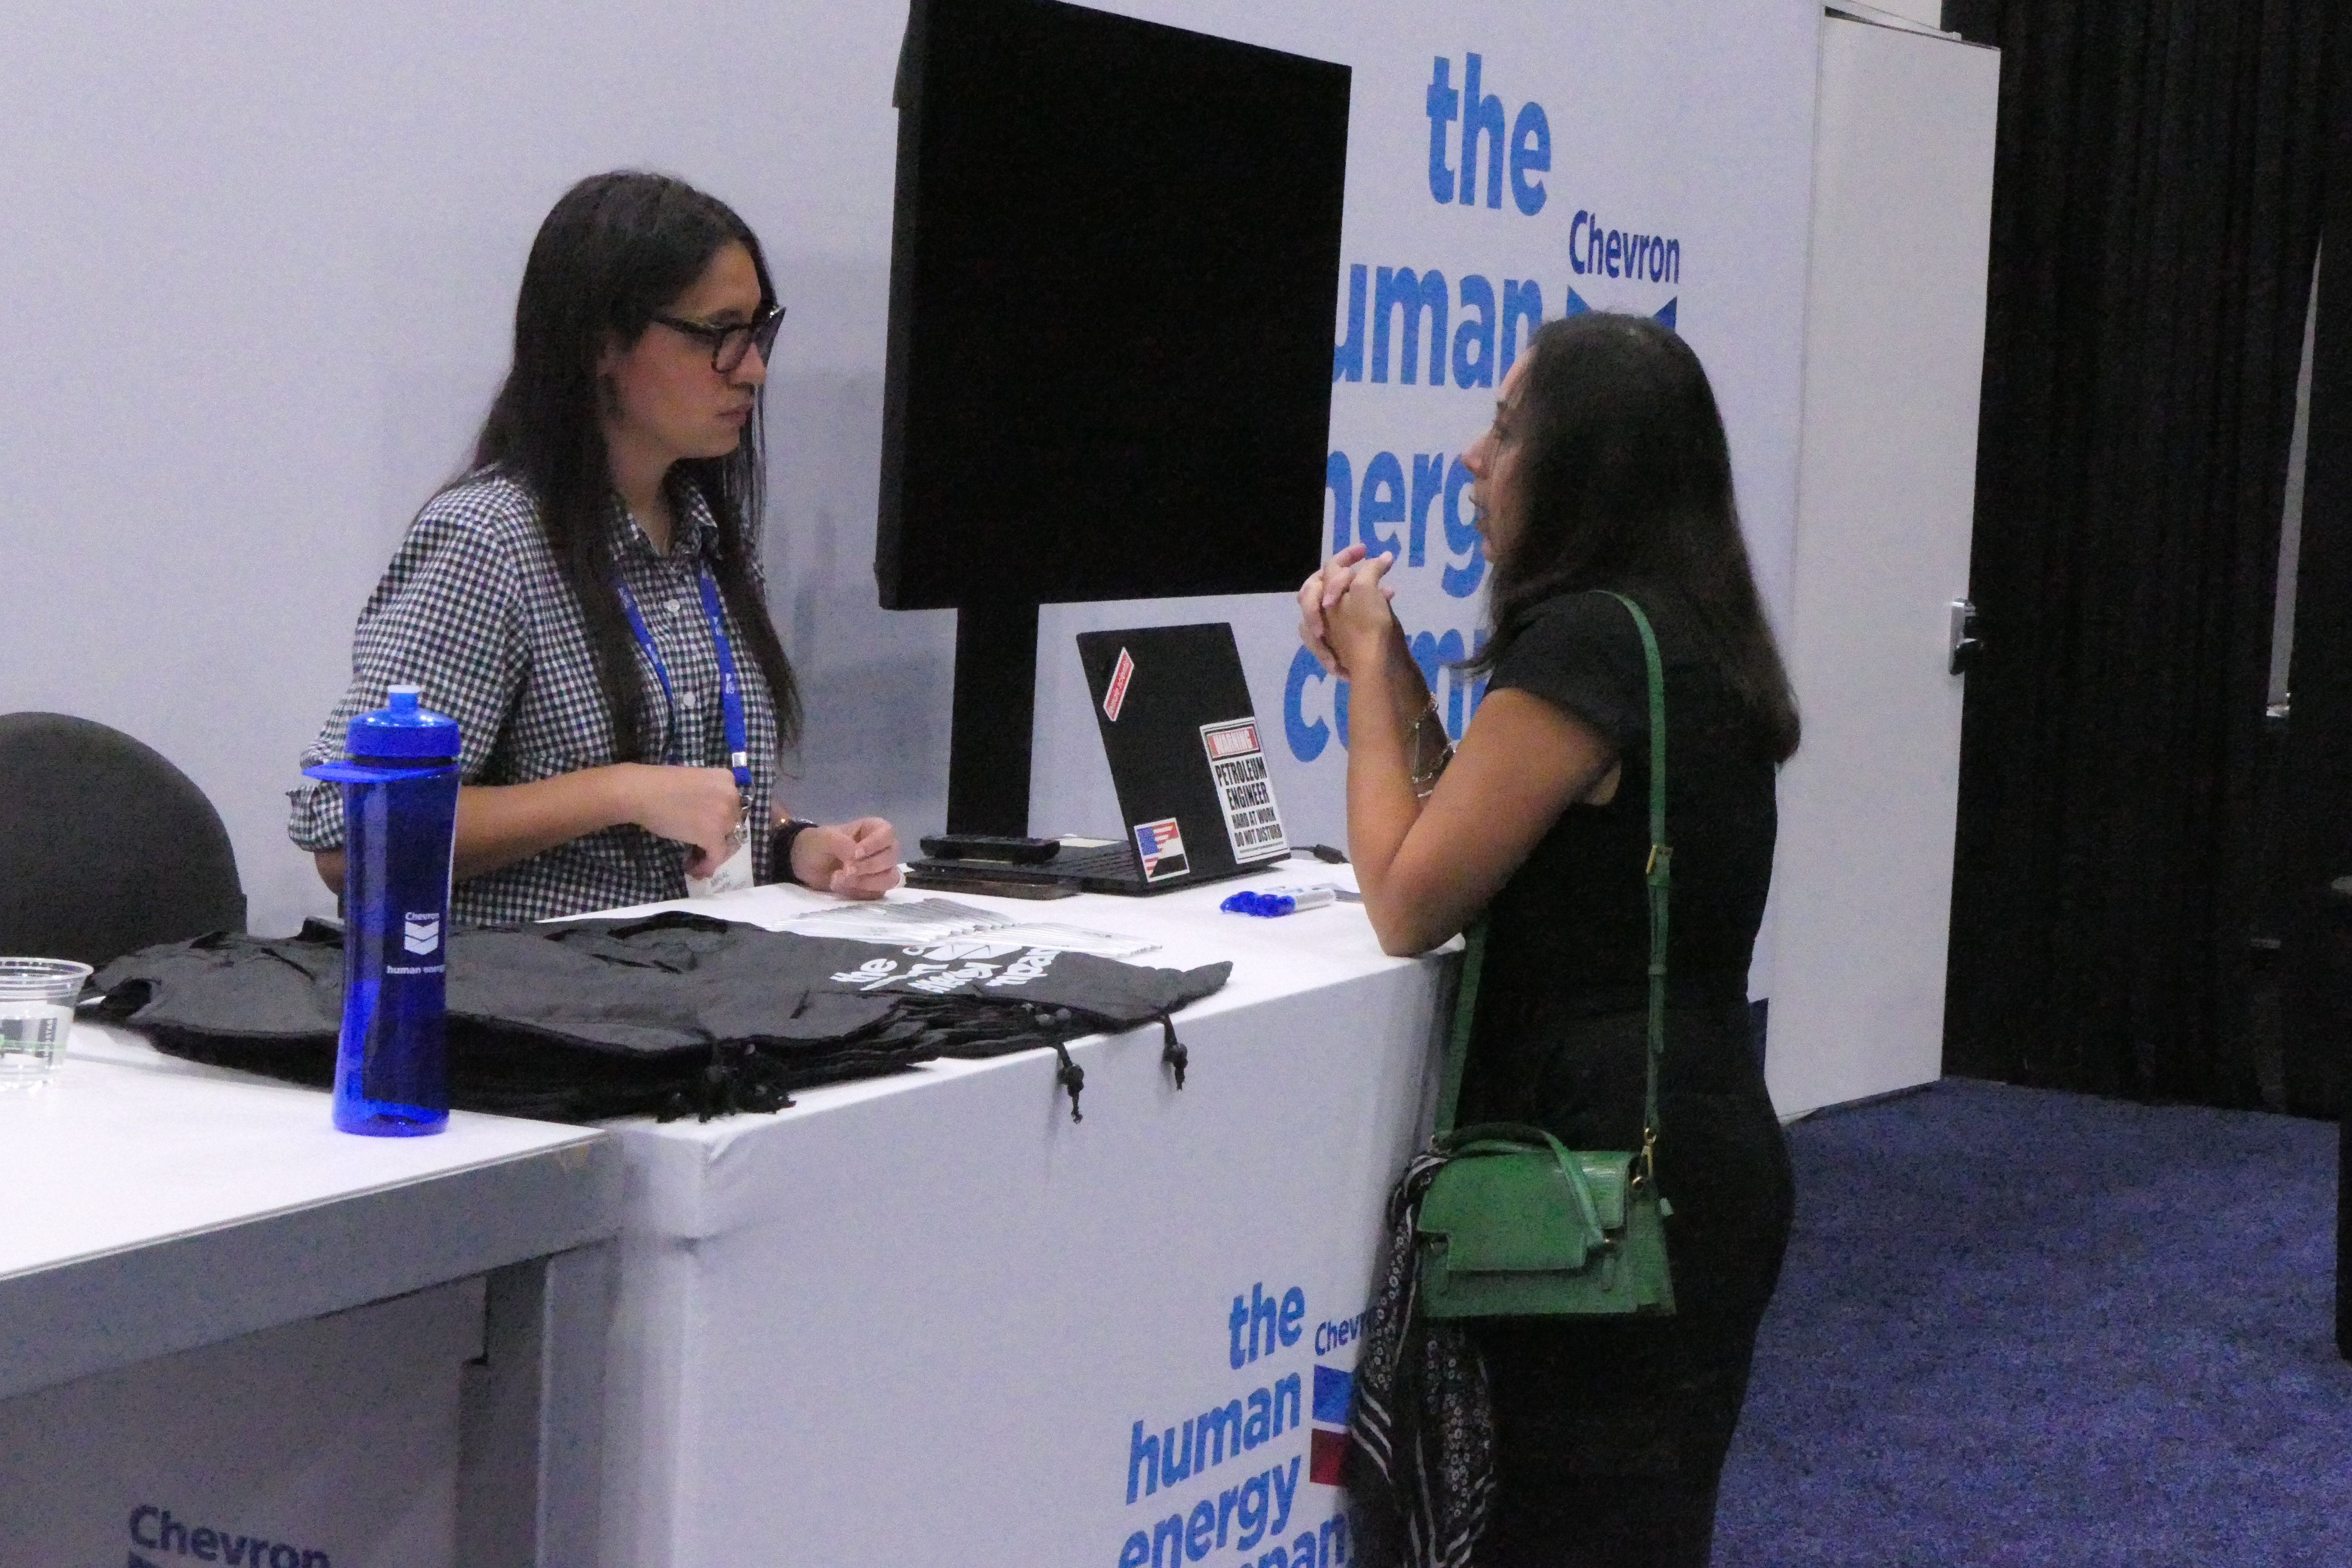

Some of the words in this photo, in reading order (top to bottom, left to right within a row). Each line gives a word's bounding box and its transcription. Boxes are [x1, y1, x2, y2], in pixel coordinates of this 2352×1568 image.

[1427, 52, 1551, 216] the
[1569, 210, 1679, 284] Chevron
[1332, 263, 1543, 389] uman
[1326, 450, 1485, 598] nerg
[1215, 756, 1267, 787] PETROLEUM
[1226, 782, 1270, 811] ENGINEER
[1231, 812, 1250, 829] HARD
[1249, 811, 1257, 826] AT
[1256, 806, 1276, 824] WORK
[1234, 832, 1244, 847] DO
[1244, 829, 1256, 845] NOT
[1256, 824, 1282, 843] DISTURB
[1229, 1282, 1305, 1370] the
[1126, 1372, 1301, 1505] human
[1118, 1455, 1301, 1568] energy
